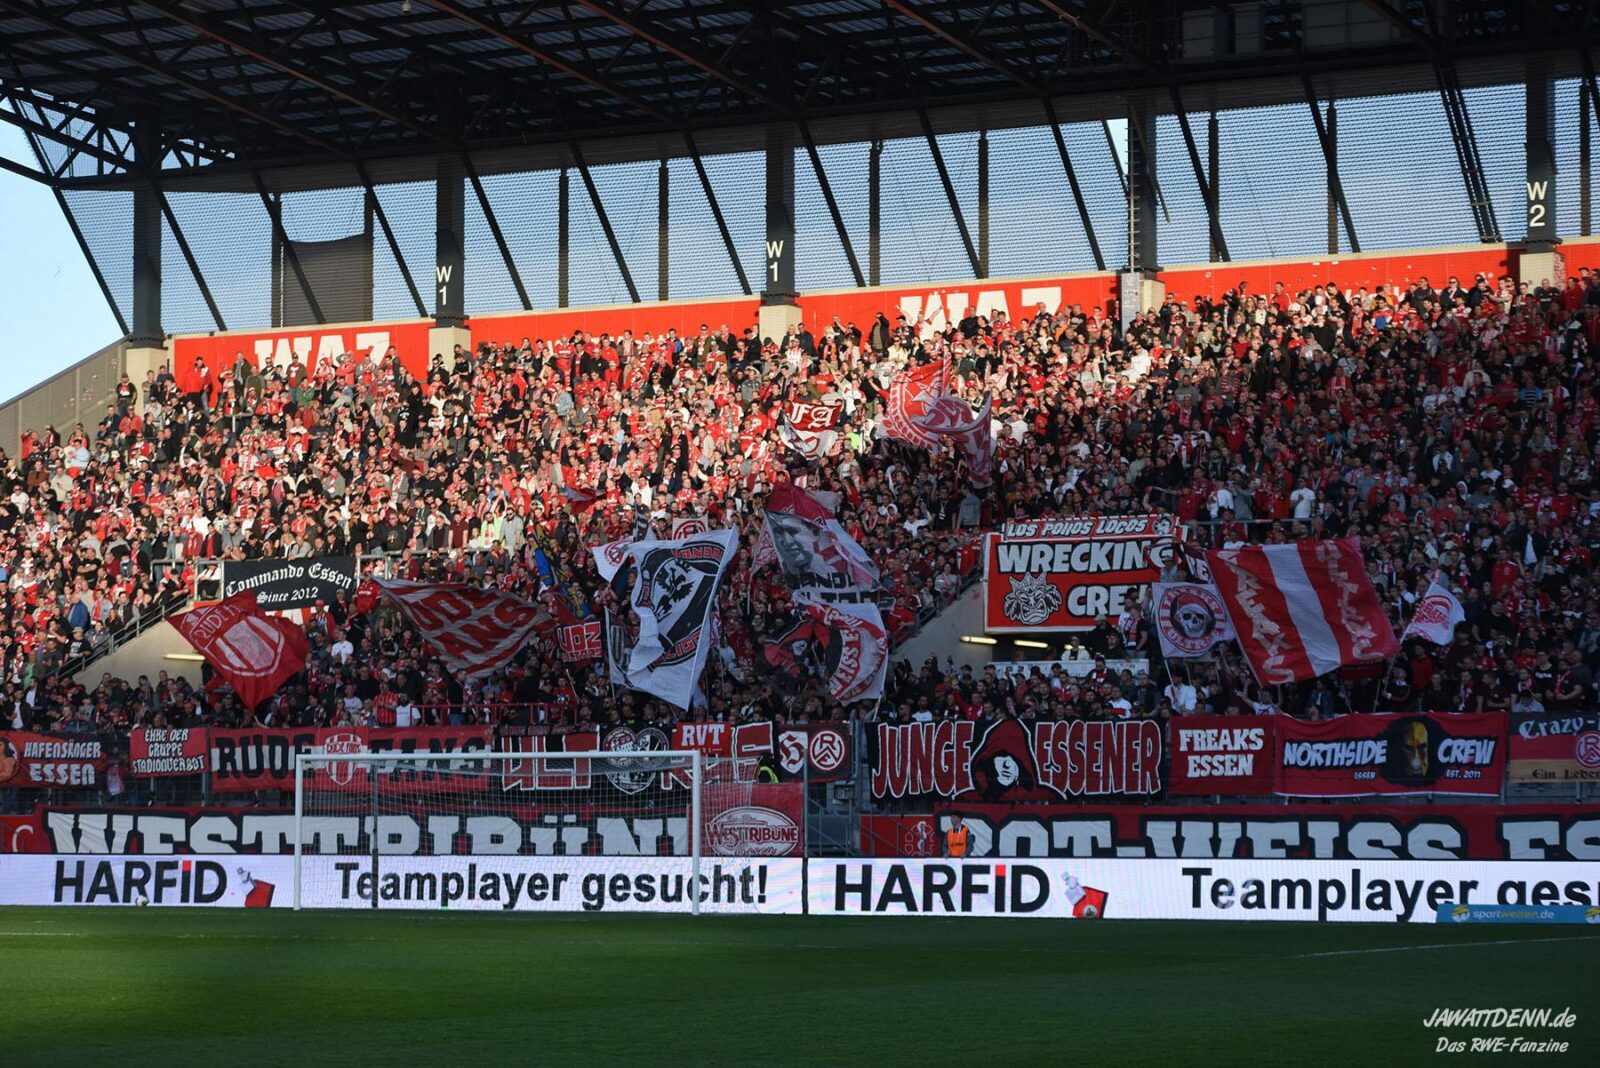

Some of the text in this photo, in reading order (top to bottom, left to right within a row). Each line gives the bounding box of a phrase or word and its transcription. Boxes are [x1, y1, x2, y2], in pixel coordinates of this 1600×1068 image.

[1527, 181, 1548, 201] W
[1529, 204, 1546, 227] 2
[766, 240, 784, 258] W
[436, 265, 452, 283] W
[769, 261, 778, 282] 1
[439, 285, 447, 305] 1
[899, 286, 1062, 344] WAZ
[254, 331, 390, 378] WAZ
[1007, 523, 1037, 537] LOS
[1096, 518, 1148, 535] LOCOS
[225, 562, 353, 598] Commando Essen
[256, 586, 320, 604] Since 2012
[1067, 584, 1150, 617] CRE
[681, 723, 725, 747] RVT
[1179, 727, 1265, 752] FREAKS
[23, 739, 102, 759] HAFENSÄNGER
[871, 719, 1162, 799] JUNGE ESSENER
[1283, 738, 1496, 767] NORTHSIDE CREW
[29, 762, 96, 786] ESSEN
[1187, 754, 1254, 778] ESSEN
[334, 862, 768, 911] Teamplayer gesucht!
[1181, 867, 1600, 922] Teamplayer ges
[1472, 909, 1556, 920] sportwetten.de
